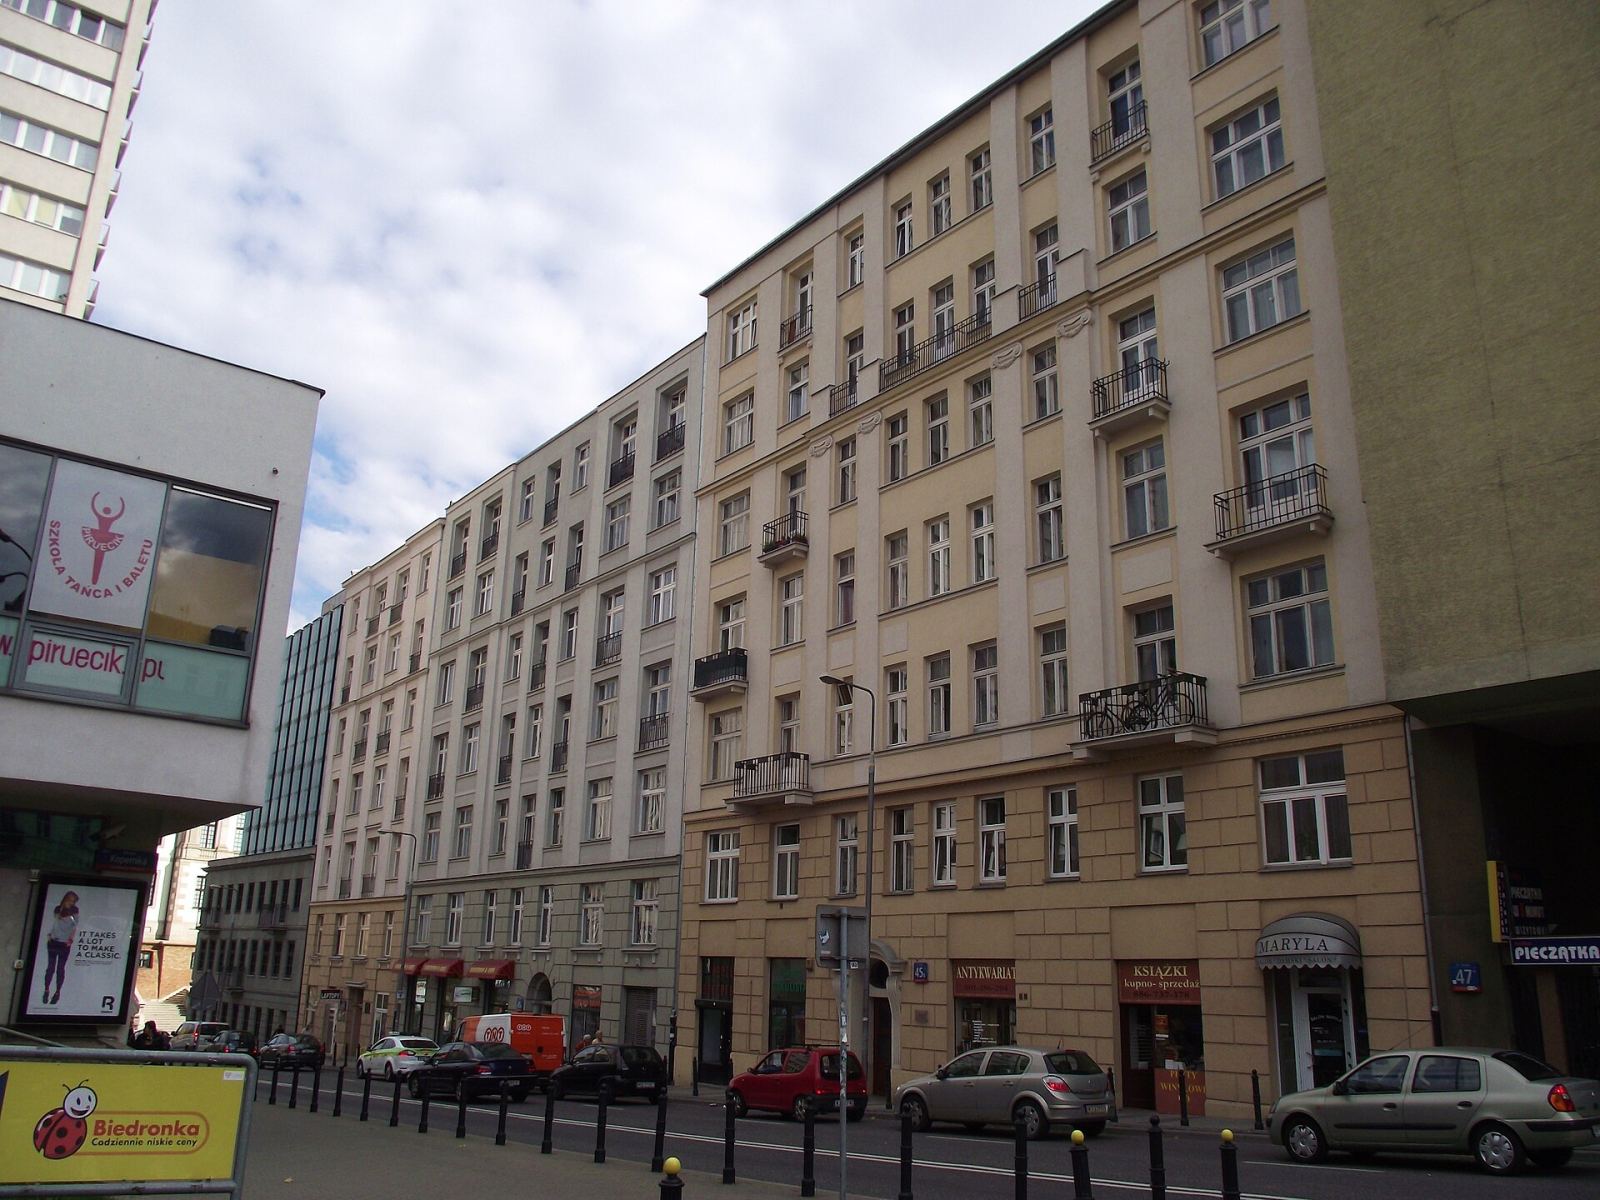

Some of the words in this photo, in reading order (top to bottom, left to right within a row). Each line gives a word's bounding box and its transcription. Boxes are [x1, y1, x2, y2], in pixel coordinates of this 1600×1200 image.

[49, 520, 66, 575] SZKOŁA
[65, 576, 112, 599] TAŃCA
[116, 584, 123, 593] I
[123, 539, 154, 587] BALETU
[89, 931, 116, 939] TAKES
[1259, 937, 1329, 953] MARYLA
[1514, 945, 1600, 963] PIECZĄTKA
[957, 965, 1016, 980] ANTYKWARIAT
[1456, 968, 1473, 985] 47
[485, 1028, 504, 1042] TNT
[93, 1119, 200, 1136] Biedronka
[91, 1137, 143, 1146] Codziennie
[147, 1137, 173, 1146] niskie
[176, 1139, 198, 1148] ceny
